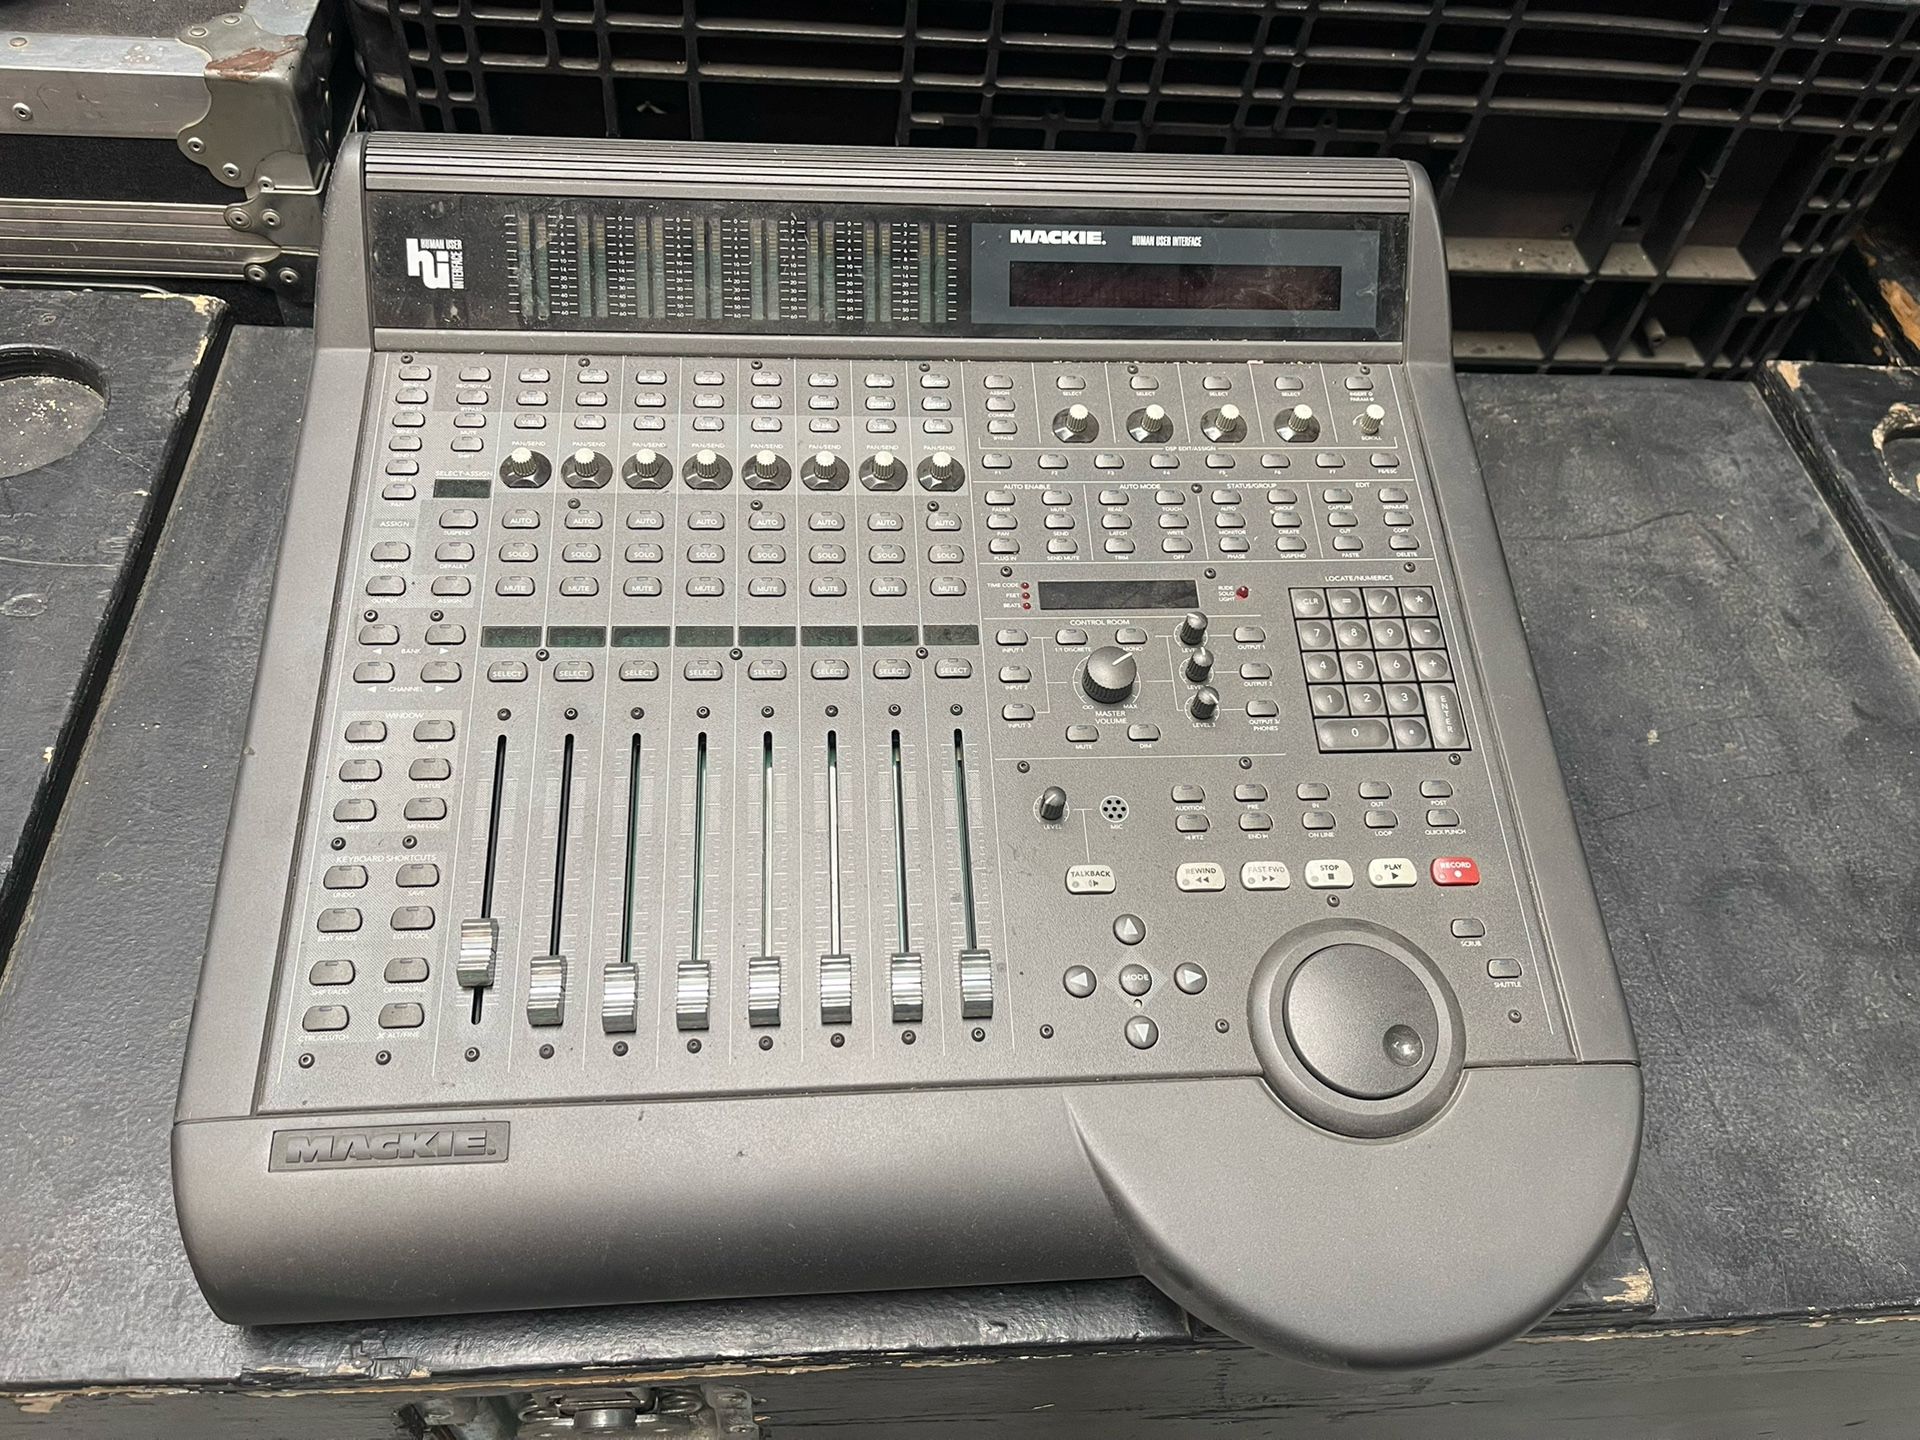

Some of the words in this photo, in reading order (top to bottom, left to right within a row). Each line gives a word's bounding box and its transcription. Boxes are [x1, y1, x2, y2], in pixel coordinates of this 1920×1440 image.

[1010, 229, 1107, 246] MACKIE.
[1132, 235, 1154, 247] HUMAN
[1155, 235, 1172, 247] USER
[1172, 235, 1202, 248] INTERFACE
[420, 238, 445, 250] HUMAN
[446, 239, 463, 250] USER
[450, 250, 465, 289] INTERFACE
[1313, 628, 1320, 637] 7
[1350, 628, 1358, 637] 8
[1386, 628, 1394, 638] 9
[1319, 660, 1327, 670] 4
[1357, 660, 1364, 670] 5
[1393, 660, 1400, 669] 6
[753, 668, 782, 676] SELECT
[878, 667, 906, 675] SELECT
[940, 667, 968, 675] SELECT
[1326, 694, 1333, 703] 1
[1363, 693, 1372, 703] 2
[1401, 692, 1408, 702] 3
[1440, 695, 1454, 733] ENTER
[1352, 728, 1359, 737] 0
[336, 855, 384, 863] KEYBOARD
[386, 854, 437, 862] SHORTCUTS
[1122, 973, 1149, 982] MODE
[285, 1128, 498, 1164] MACKIE.
